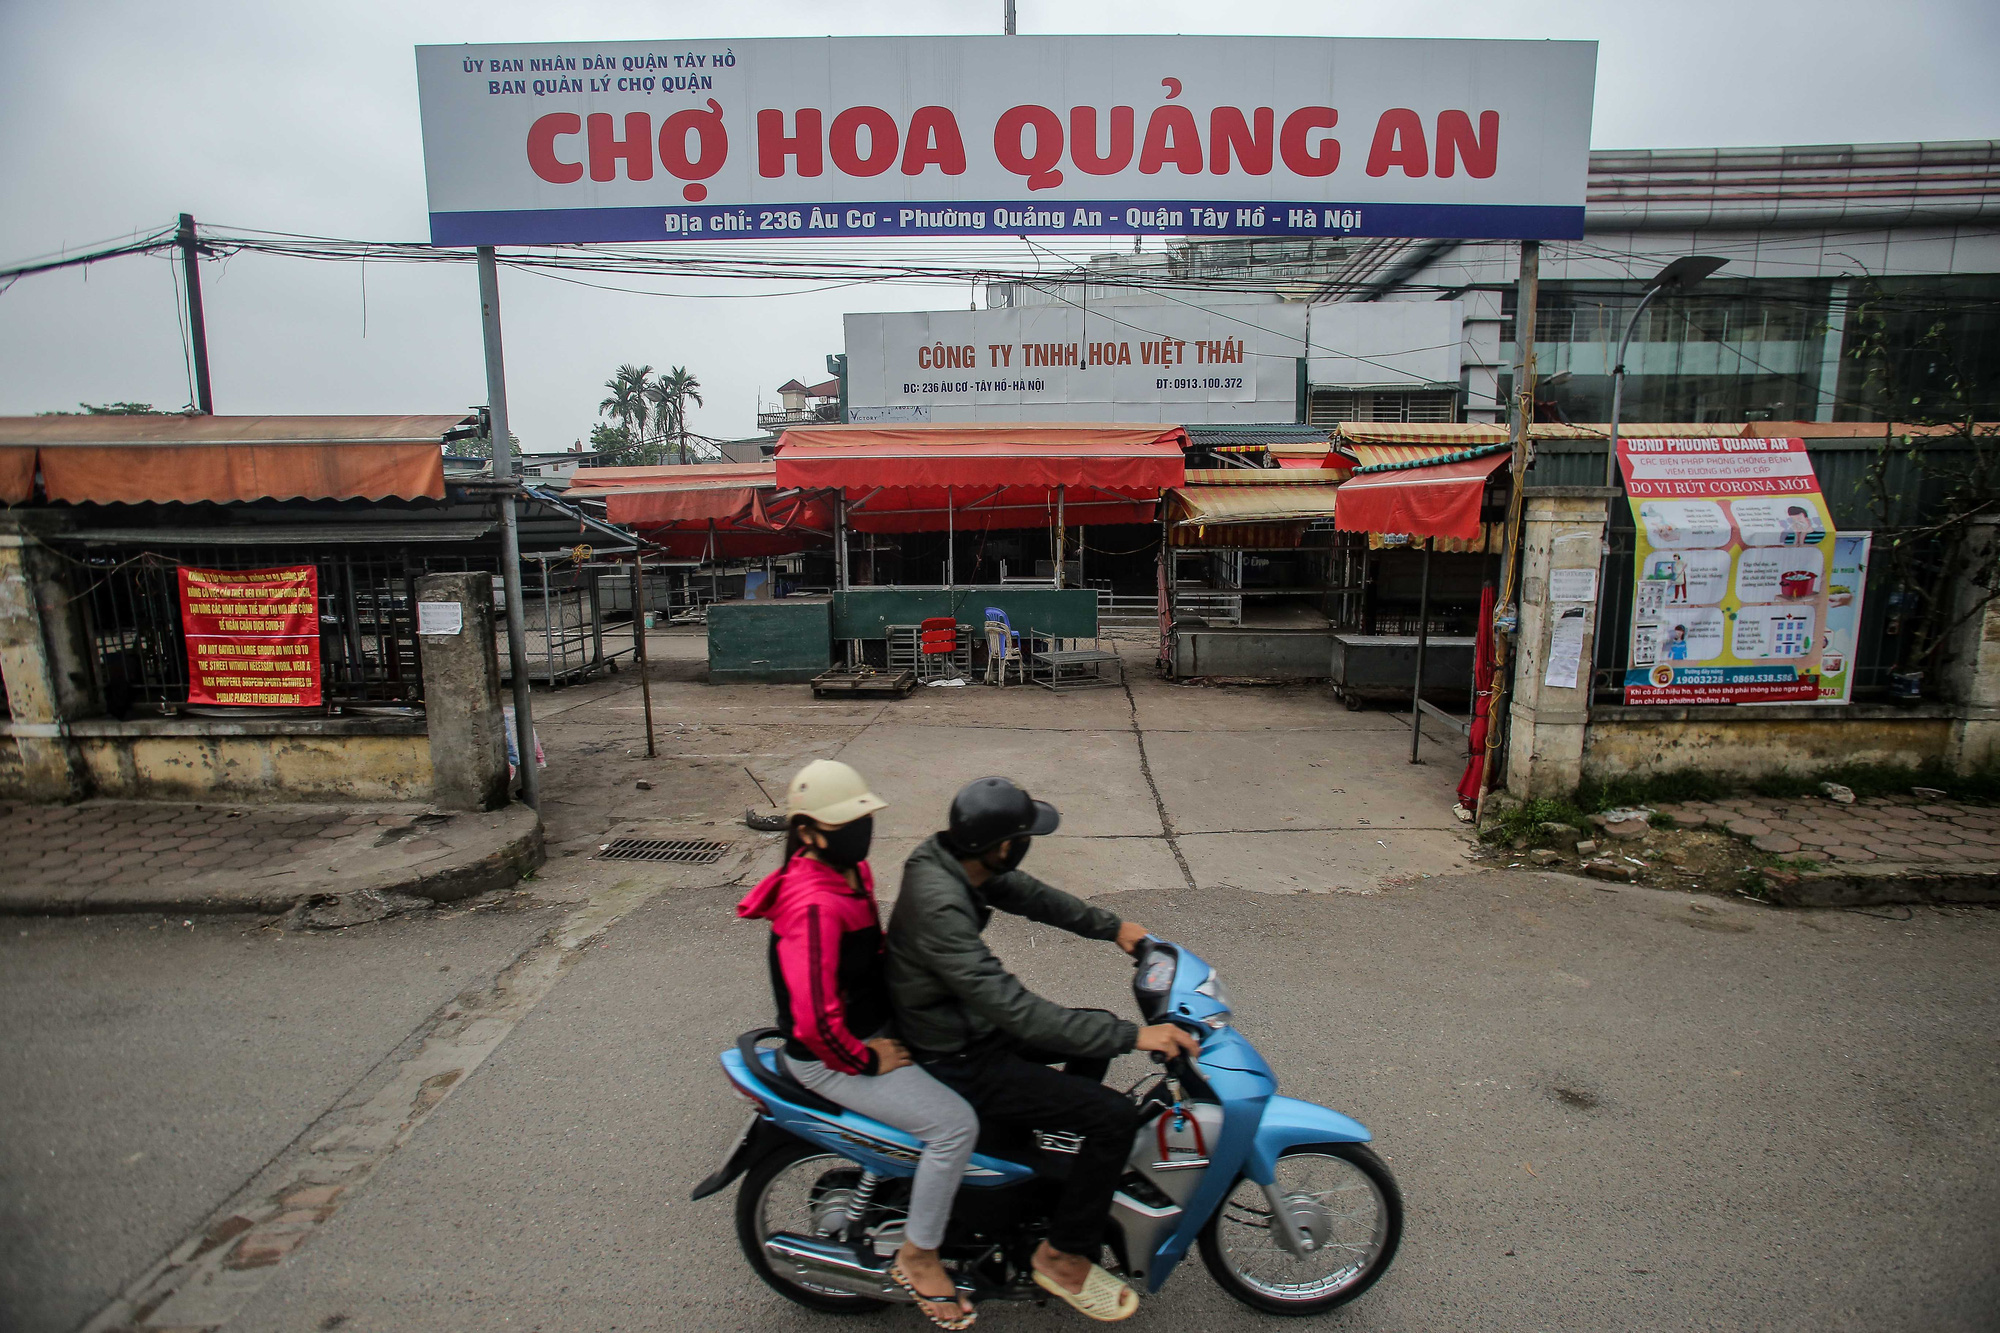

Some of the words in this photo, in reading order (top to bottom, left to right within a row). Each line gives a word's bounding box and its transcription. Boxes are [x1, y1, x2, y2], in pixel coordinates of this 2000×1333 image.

[463, 56, 484, 73] ỦY
[490, 59, 524, 72] BAN
[530, 55, 576, 72] NHÂN
[582, 54, 616, 71] DÂN
[622, 52, 668, 73] QUẬN
[673, 51, 706, 69] TÂY
[712, 47, 736, 68] HỒ
[488, 79, 526, 95] BAN
[533, 75, 583, 96] QUẢN
[590, 74, 611, 93] LÝ
[617, 76, 656, 95] CHỢ
[661, 72, 712, 94] QUẬN
[526, 97, 729, 203] CHỢ
[756, 105, 967, 178] HOA
[993, 76, 1341, 191] QUẢNG
[1365, 107, 1500, 179] AN
[665, 212, 703, 236] Địa
[710, 209, 752, 231] chỉ:
[759, 211, 802, 231] 236
[809, 207, 839, 229] Âu
[846, 210, 876, 229] Cơ
[899, 208, 986, 229] Phường
[993, 206, 1065, 228] Quảng
[1072, 209, 1101, 227] An
[1126, 208, 1182, 231] Quận
[1190, 207, 1229, 229] Tây
[1236, 206, 1265, 227] Hồ
[1288, 208, 1317, 227] Hà
[1324, 209, 1361, 232] Nội
[918, 341, 976, 369] CÔNG
[988, 344, 1013, 367] TY
[1022, 343, 1078, 367] TNHH
[1088, 342, 1131, 366] HOA
[1140, 336, 1186, 369] VIỆT
[1195, 335, 1243, 364] THÁI
[922, 383, 939, 393] 236
[941, 381, 953, 392] ÂU
[1028, 378, 1044, 393] NỘI
[1627, 438, 1664, 452] UBND
[1770, 438, 1789, 450] AN
[1629, 482, 1652, 494] DO
[1654, 482, 1672, 494] VI
[1674, 479, 1706, 494] RÚT
[1710, 480, 1777, 494] CORONA
